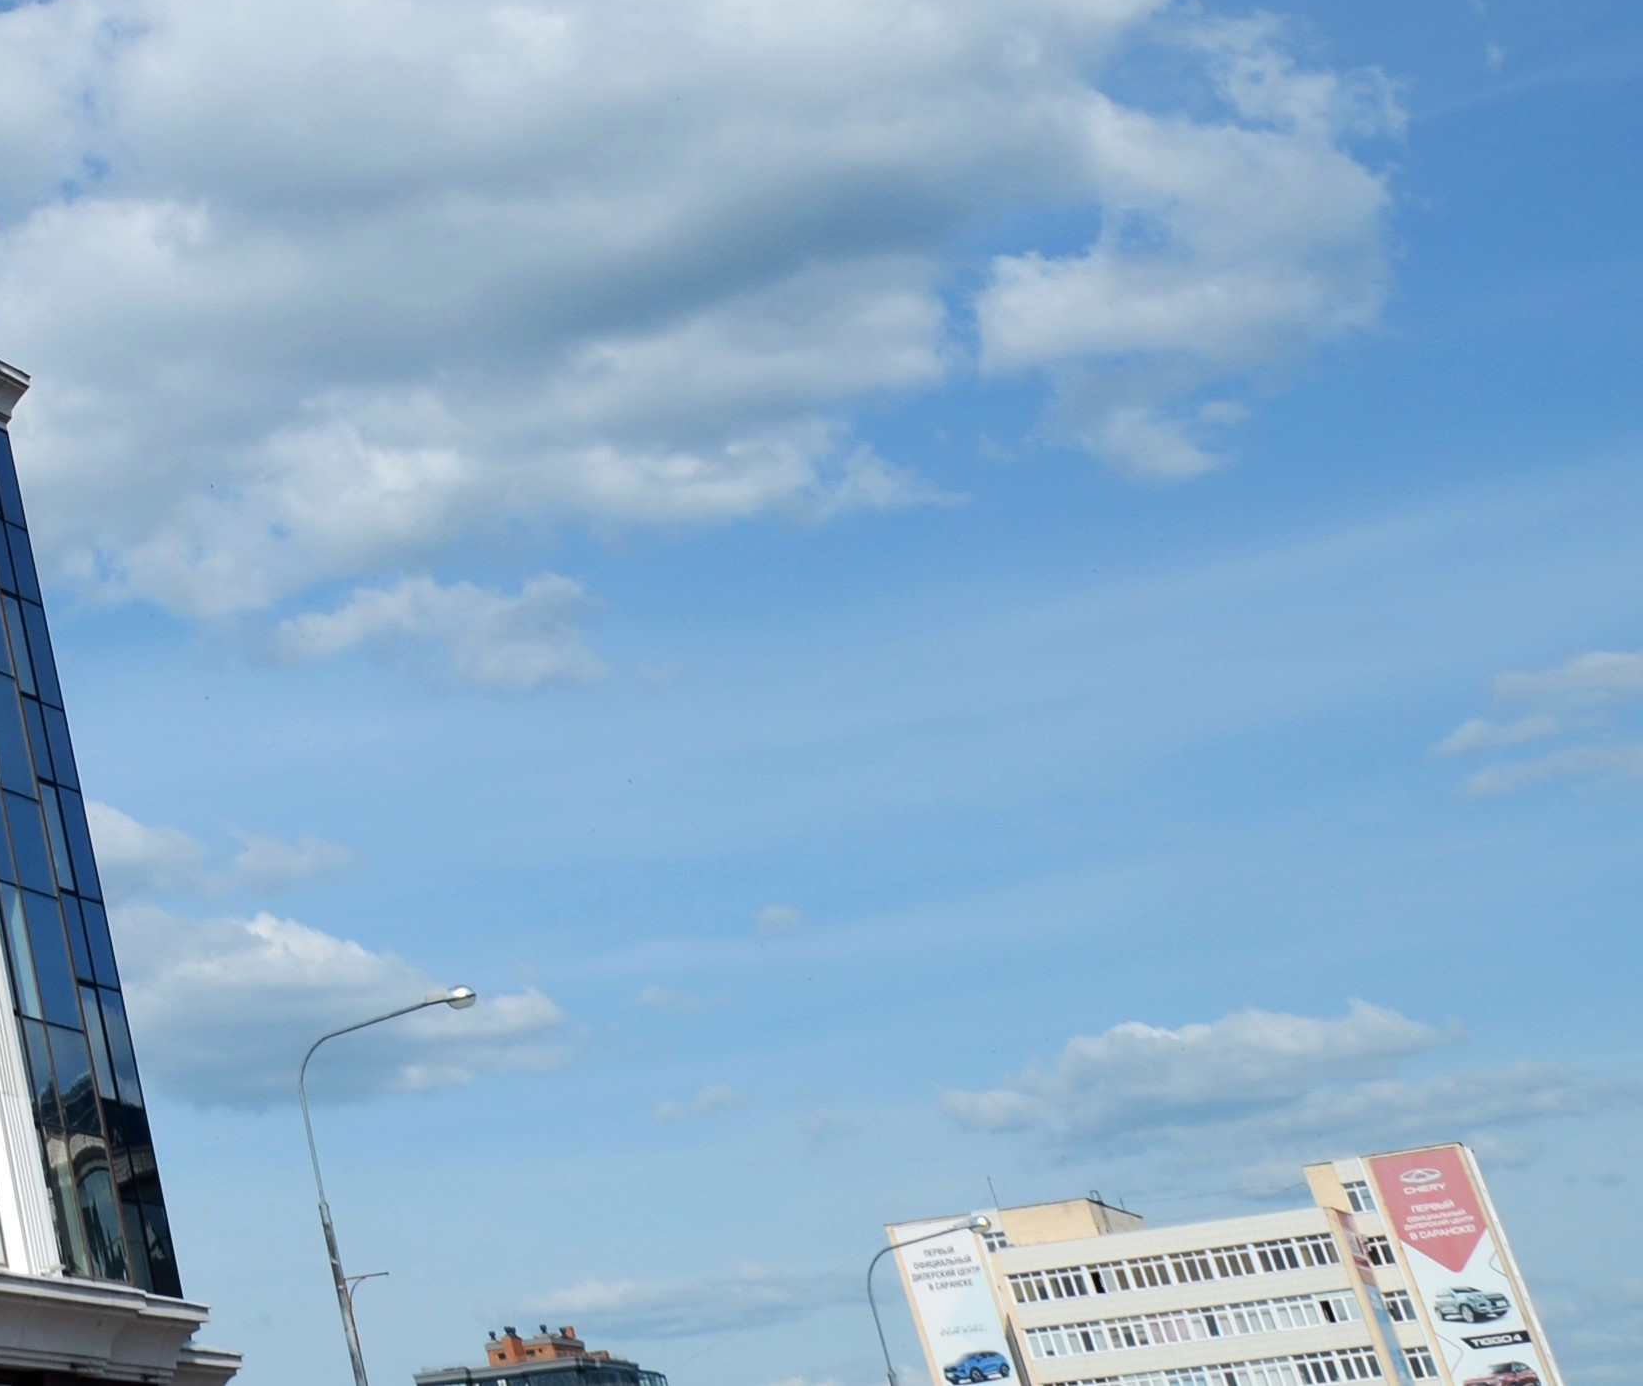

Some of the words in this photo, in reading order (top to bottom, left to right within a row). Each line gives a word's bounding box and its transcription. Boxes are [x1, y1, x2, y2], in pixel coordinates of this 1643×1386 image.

[1403, 1182, 1446, 1195] CHERY
[1410, 1199, 1455, 1213] ПЕРВЫЙ
[1406, 1209, 1467, 1223] ОФИЦИАЛЬНЫЙ
[1450, 1215, 1475, 1225] ЦЕНТР
[1409, 1232, 1418, 1240] В
[923, 1245, 955, 1257] ПЕРВЫЙ
[913, 1254, 972, 1270] ОФИЦИАЛЬНЫЙ
[911, 1269, 956, 1282] ДИЛЕРСКИЙ
[956, 1265, 981, 1277] ЦЕНТР
[928, 1283, 934, 1291] В
[935, 1278, 972, 1290] САРАНСКЕ
[1470, 1334, 1513, 1347] TIGGO
